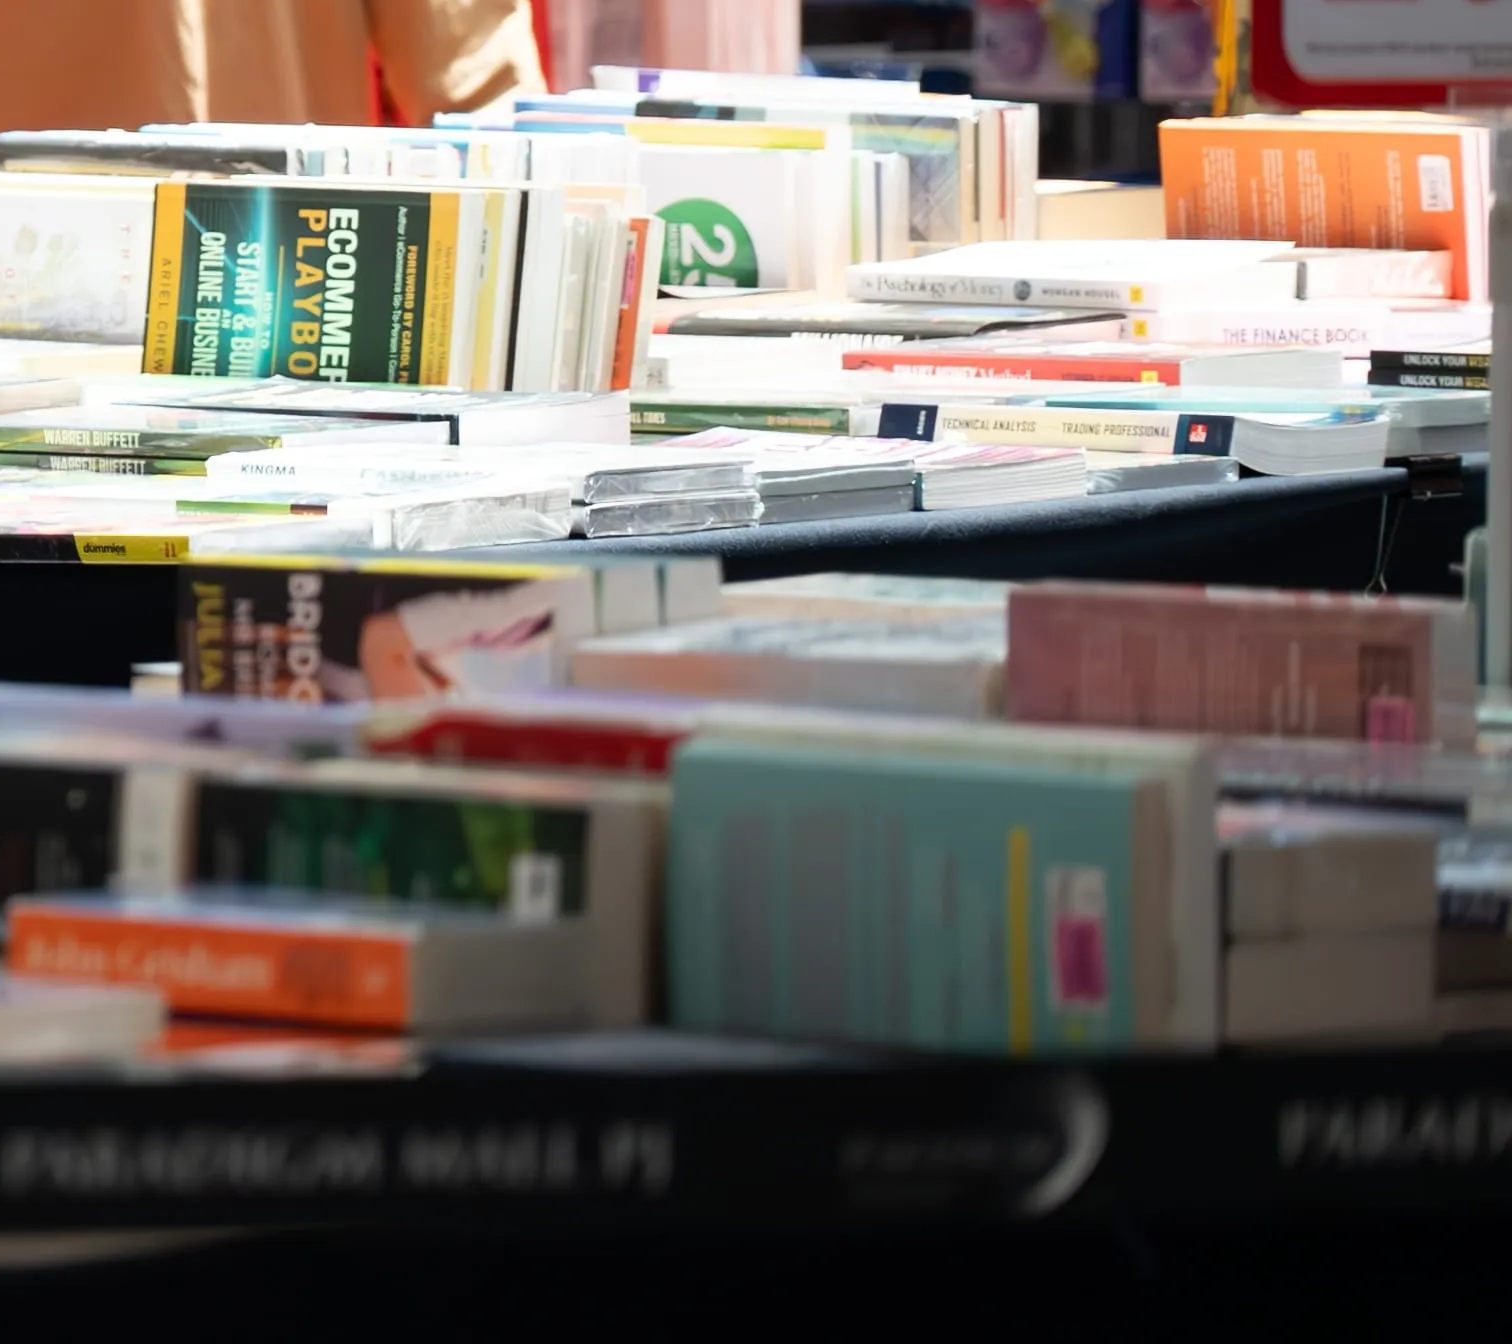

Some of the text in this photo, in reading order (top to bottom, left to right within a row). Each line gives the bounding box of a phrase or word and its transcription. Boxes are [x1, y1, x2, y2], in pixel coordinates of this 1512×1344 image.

[197, 232, 227, 302] ONLINE
[233, 242, 261, 308] START
[287, 208, 328, 376] PLAYBO
[1223, 328, 1248, 344] THE
[1253, 328, 1321, 345] FINANCE
[942, 417, 991, 431] TECHNICAL
[993, 419, 1037, 433] ANALYSIS
[1062, 421, 1171, 438] TRADING PROFESSIONAL
[44, 429, 141, 449] WARREN BUFFETT
[240, 464, 296, 477] KINGMA
[82, 541, 126, 555] dummies
[192, 582, 224, 689] JULIA
